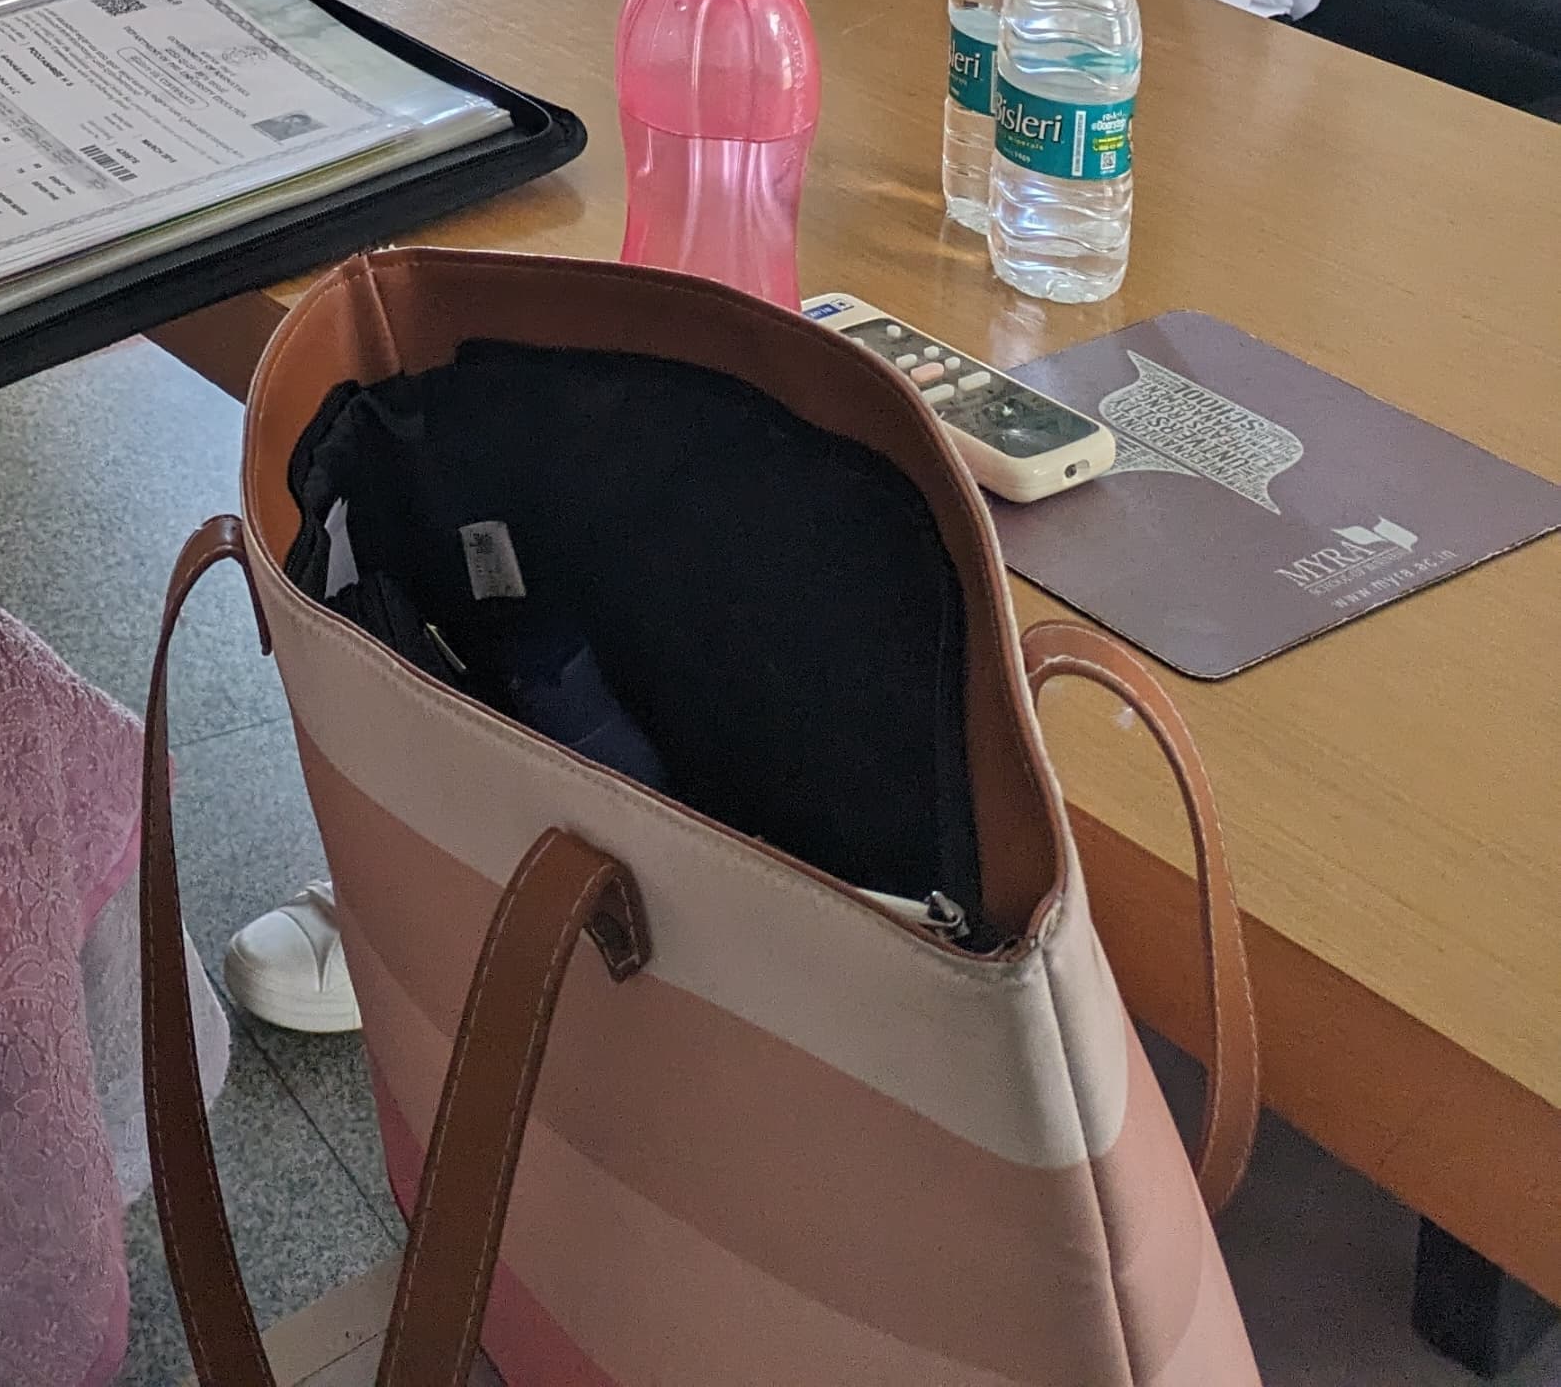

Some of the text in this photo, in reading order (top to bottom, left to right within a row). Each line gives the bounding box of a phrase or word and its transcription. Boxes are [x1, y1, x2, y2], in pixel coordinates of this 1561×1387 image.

[995, 90, 1063, 143] Bisleri
[1109, 393, 1249, 471] UNIVERSITY
[1172, 382, 1265, 434] SCHOOL
[1106, 408, 1238, 483] INTERNATIONAL
[1274, 540, 1376, 587] MYRA
[1331, 548, 1457, 609] www.myra.ac.in
